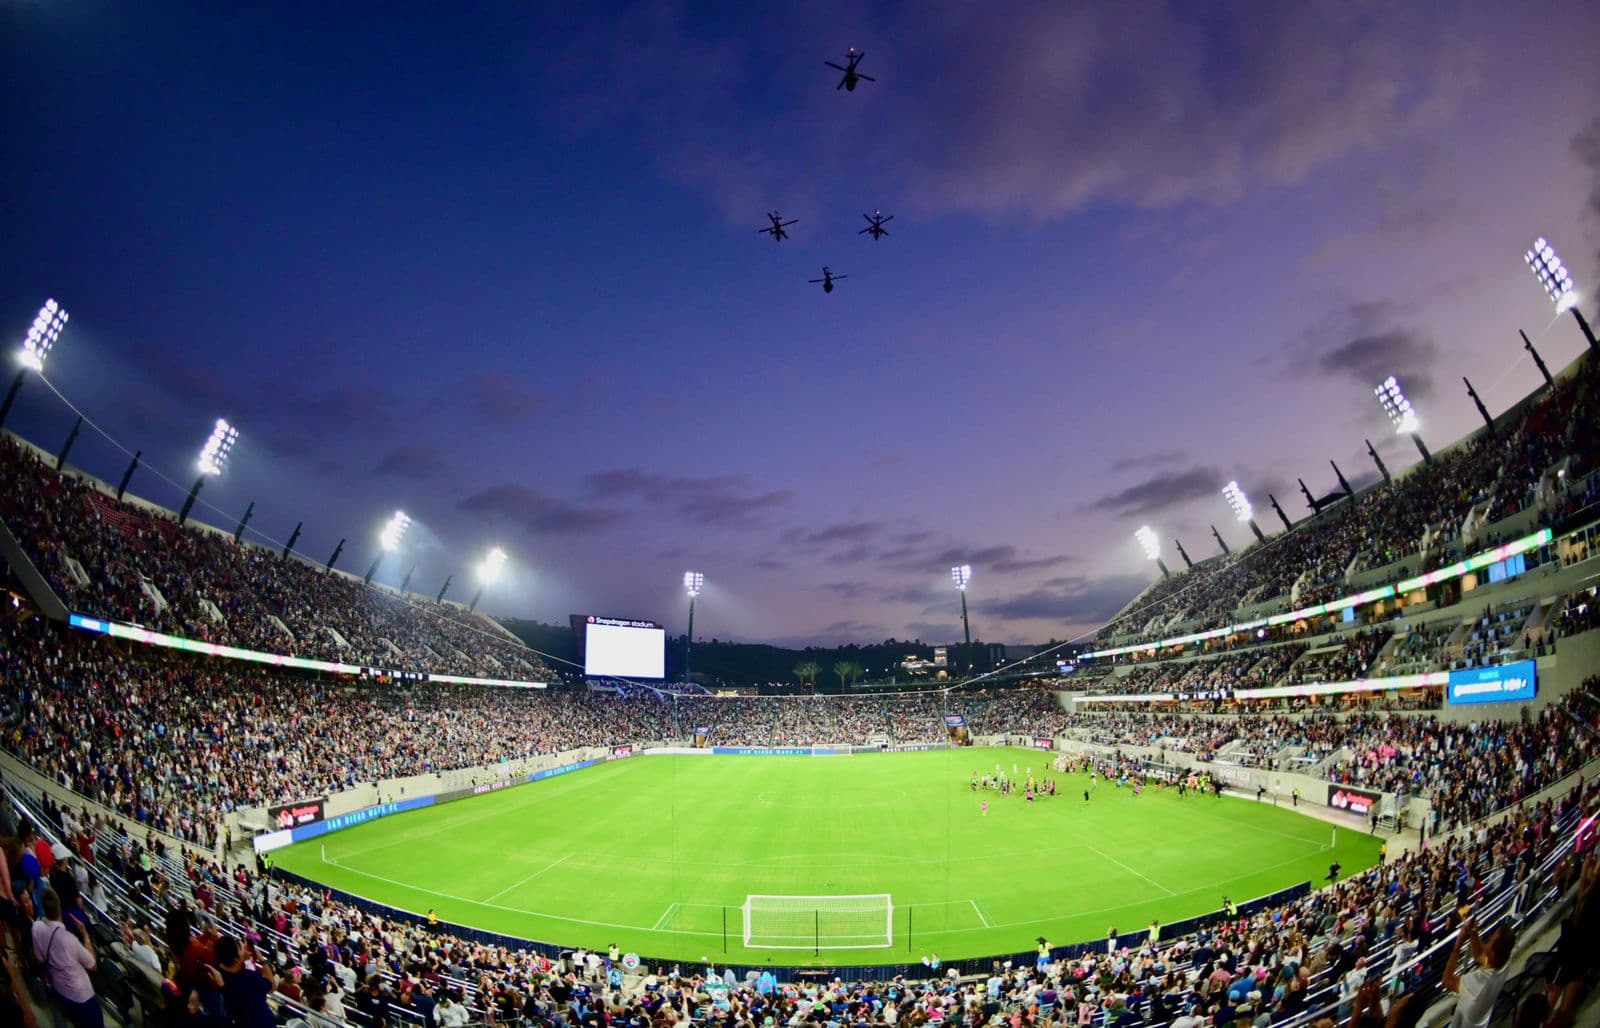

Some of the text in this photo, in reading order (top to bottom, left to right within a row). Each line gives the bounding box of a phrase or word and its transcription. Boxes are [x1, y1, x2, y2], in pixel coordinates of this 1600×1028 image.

[596, 617, 630, 627] Snapdragon
[327, 803, 399, 830] SAN DIEGO WAVE FC
